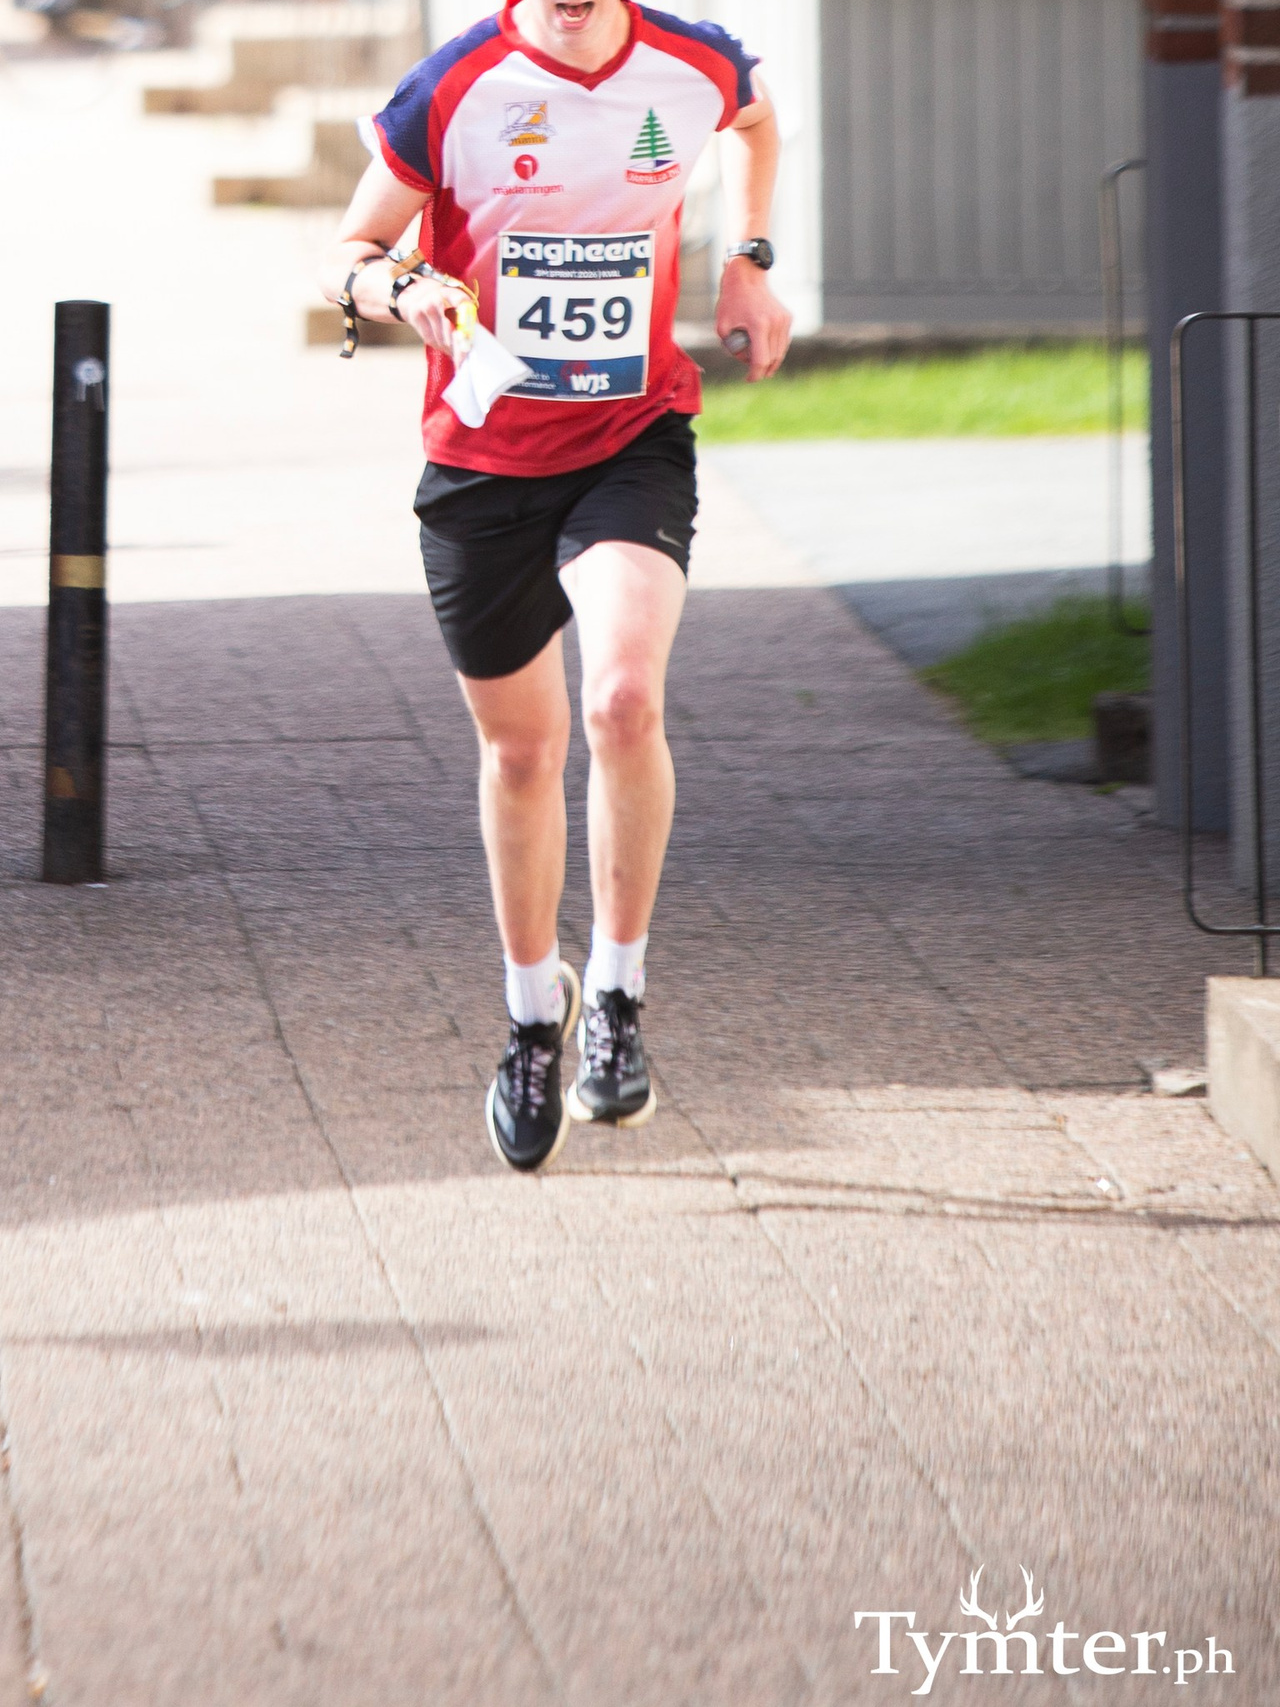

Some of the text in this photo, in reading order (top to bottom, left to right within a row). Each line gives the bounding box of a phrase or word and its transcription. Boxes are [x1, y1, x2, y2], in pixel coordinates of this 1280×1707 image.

[501, 236, 652, 267] bagheera
[518, 295, 634, 342] 459
[570, 372, 611, 395] WJS
